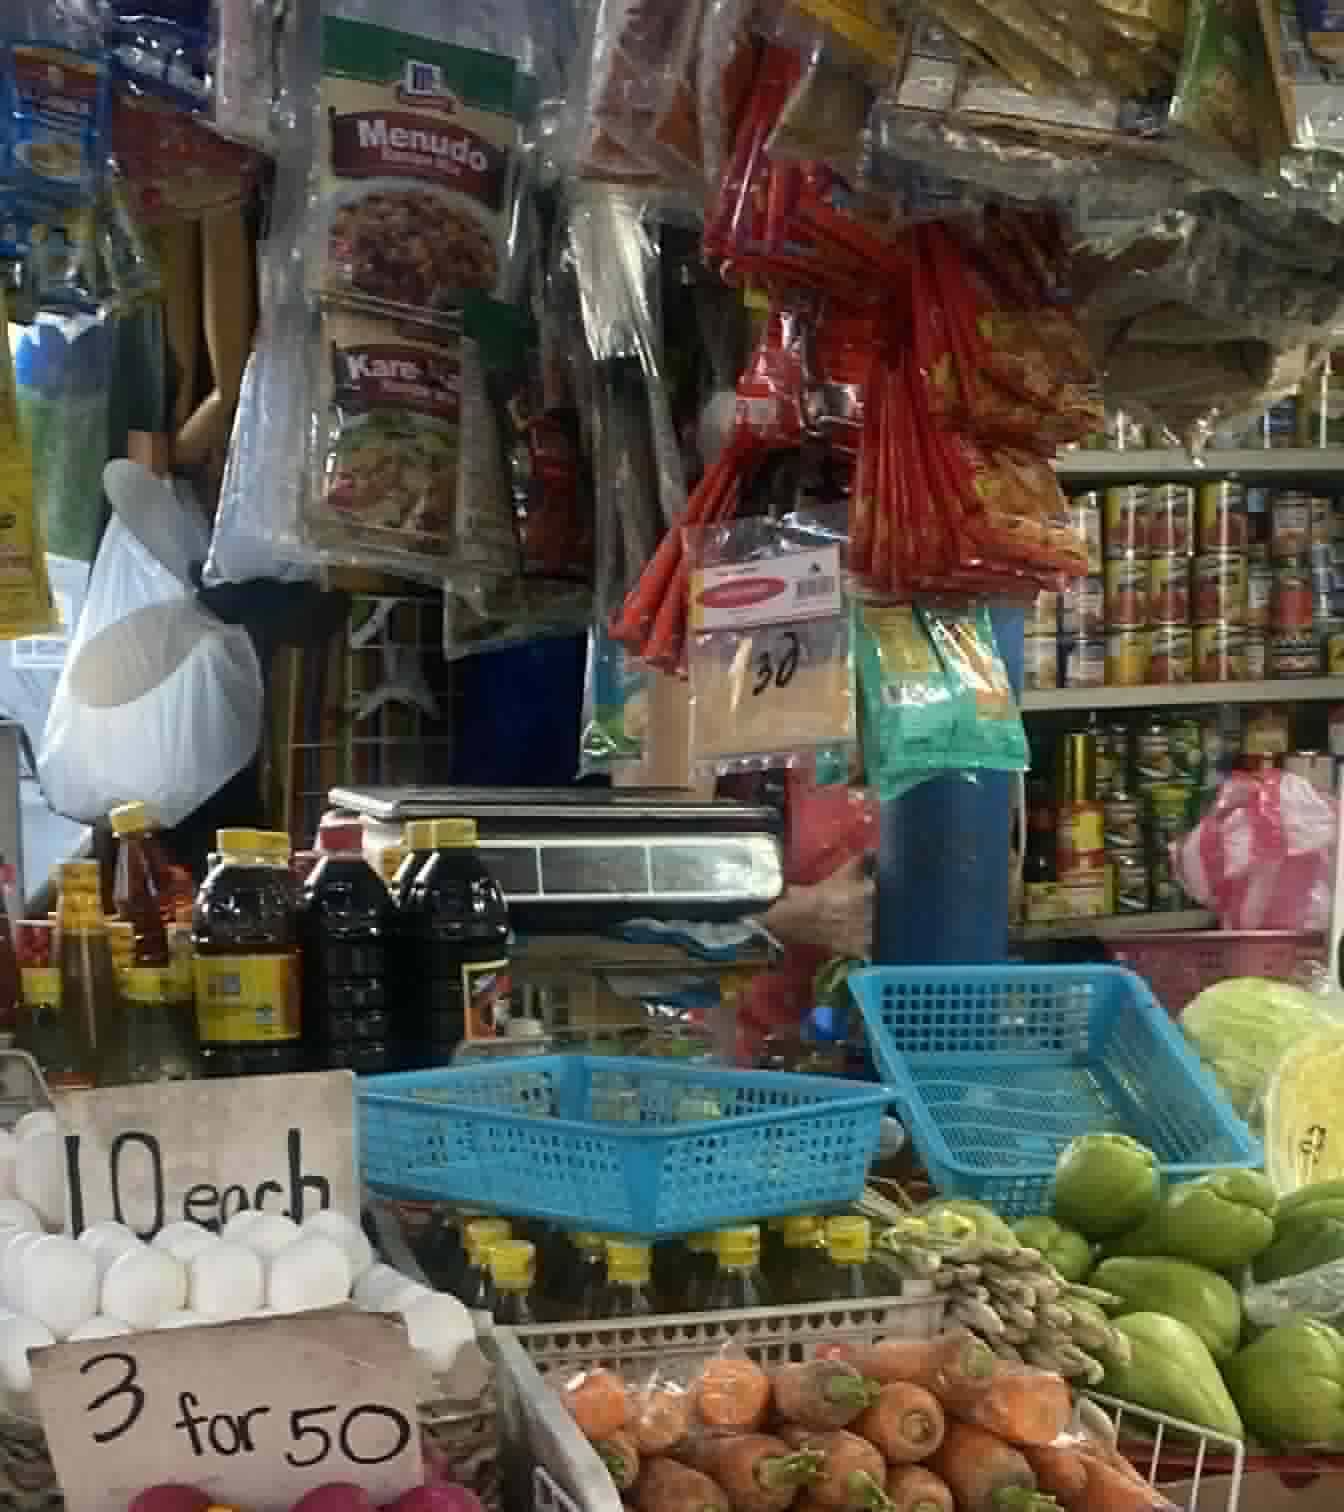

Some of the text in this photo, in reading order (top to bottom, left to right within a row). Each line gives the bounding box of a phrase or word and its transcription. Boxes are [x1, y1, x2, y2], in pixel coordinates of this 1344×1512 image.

[356, 118, 490, 173] Menudo
[753, 631, 802, 697] 30
[63, 1127, 331, 1243] 10 each
[78, 1351, 412, 1467] 3 for 50
